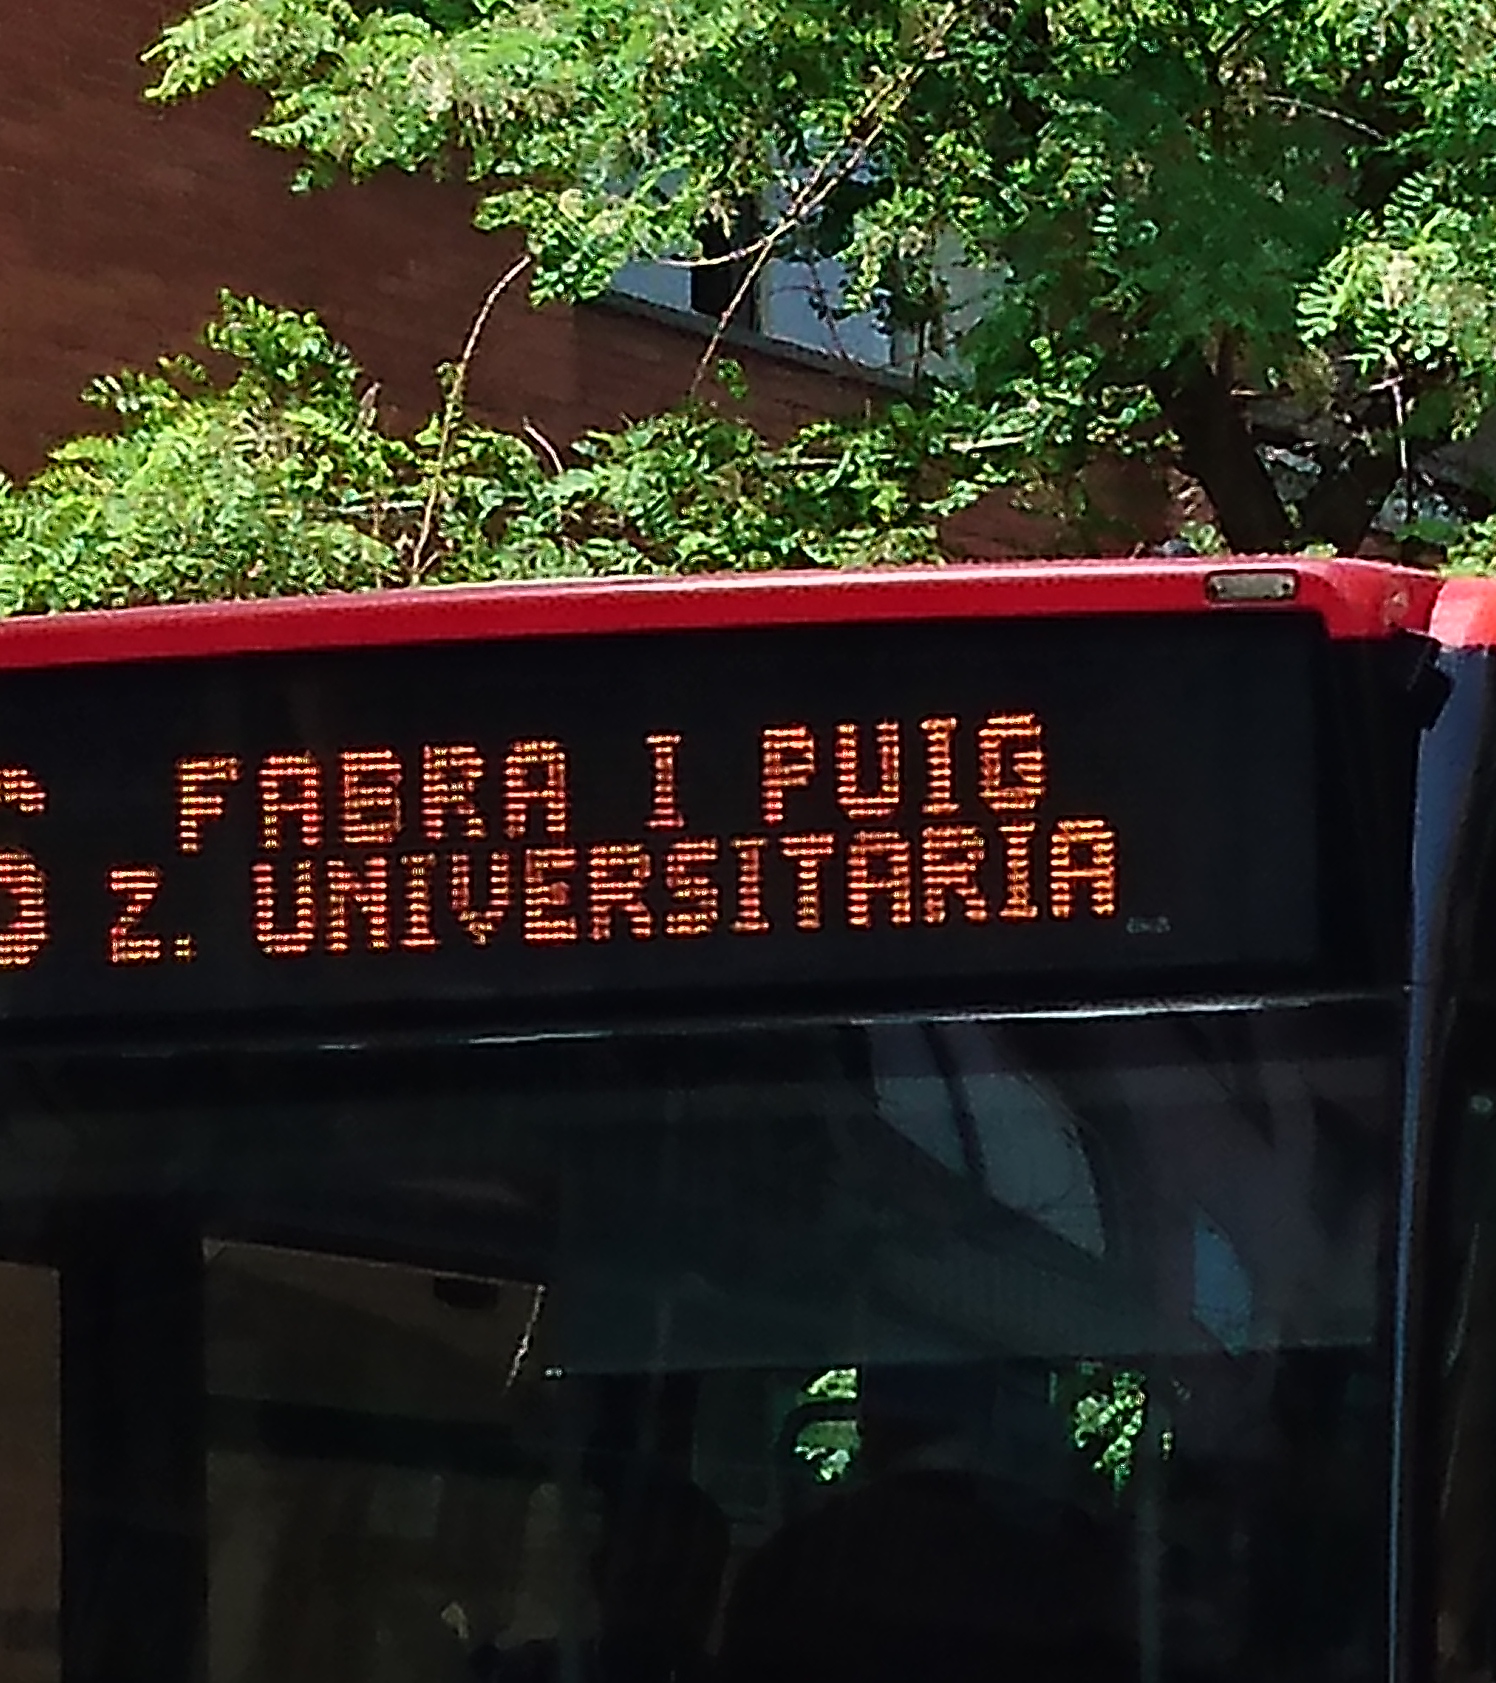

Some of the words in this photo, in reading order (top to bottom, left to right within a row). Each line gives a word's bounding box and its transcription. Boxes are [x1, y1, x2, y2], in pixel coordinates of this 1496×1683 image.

[173, 737, 569, 856] FABRA
[642, 728, 687, 832] I
[758, 710, 1048, 827] PUIG
[250, 815, 1121, 958] UNIVERSITARIA
